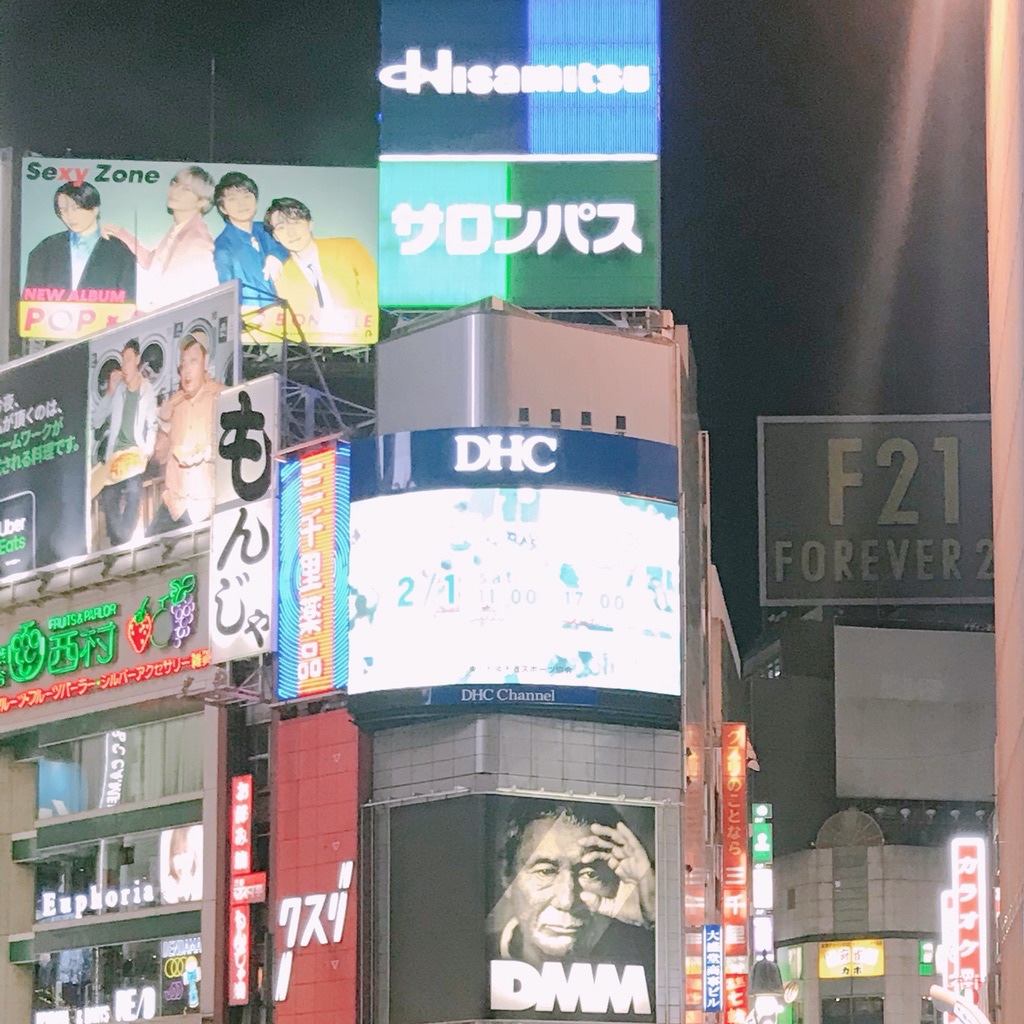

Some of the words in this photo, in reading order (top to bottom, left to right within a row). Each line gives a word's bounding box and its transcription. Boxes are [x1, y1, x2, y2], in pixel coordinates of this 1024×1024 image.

[27, 161, 88, 185] Sexy
[94, 165, 160, 185] Zone
[392, 203, 643, 256] サロンパス
[24, 288, 65, 302] NEW
[67, 289, 126, 303] ALBUM
[24, 306, 97, 332] POP
[454, 434, 557, 473] DHC
[827, 437, 959, 526] F21
[216, 389, 272, 648] もんじゃ
[774, 538, 962, 583] FOREVER
[48, 620, 117, 675] 西村
[461, 689, 494, 701] DHC
[496, 689, 556, 702] Channel
[42, 878, 156, 920] Euphoria
[490, 960, 652, 1014] DMM
